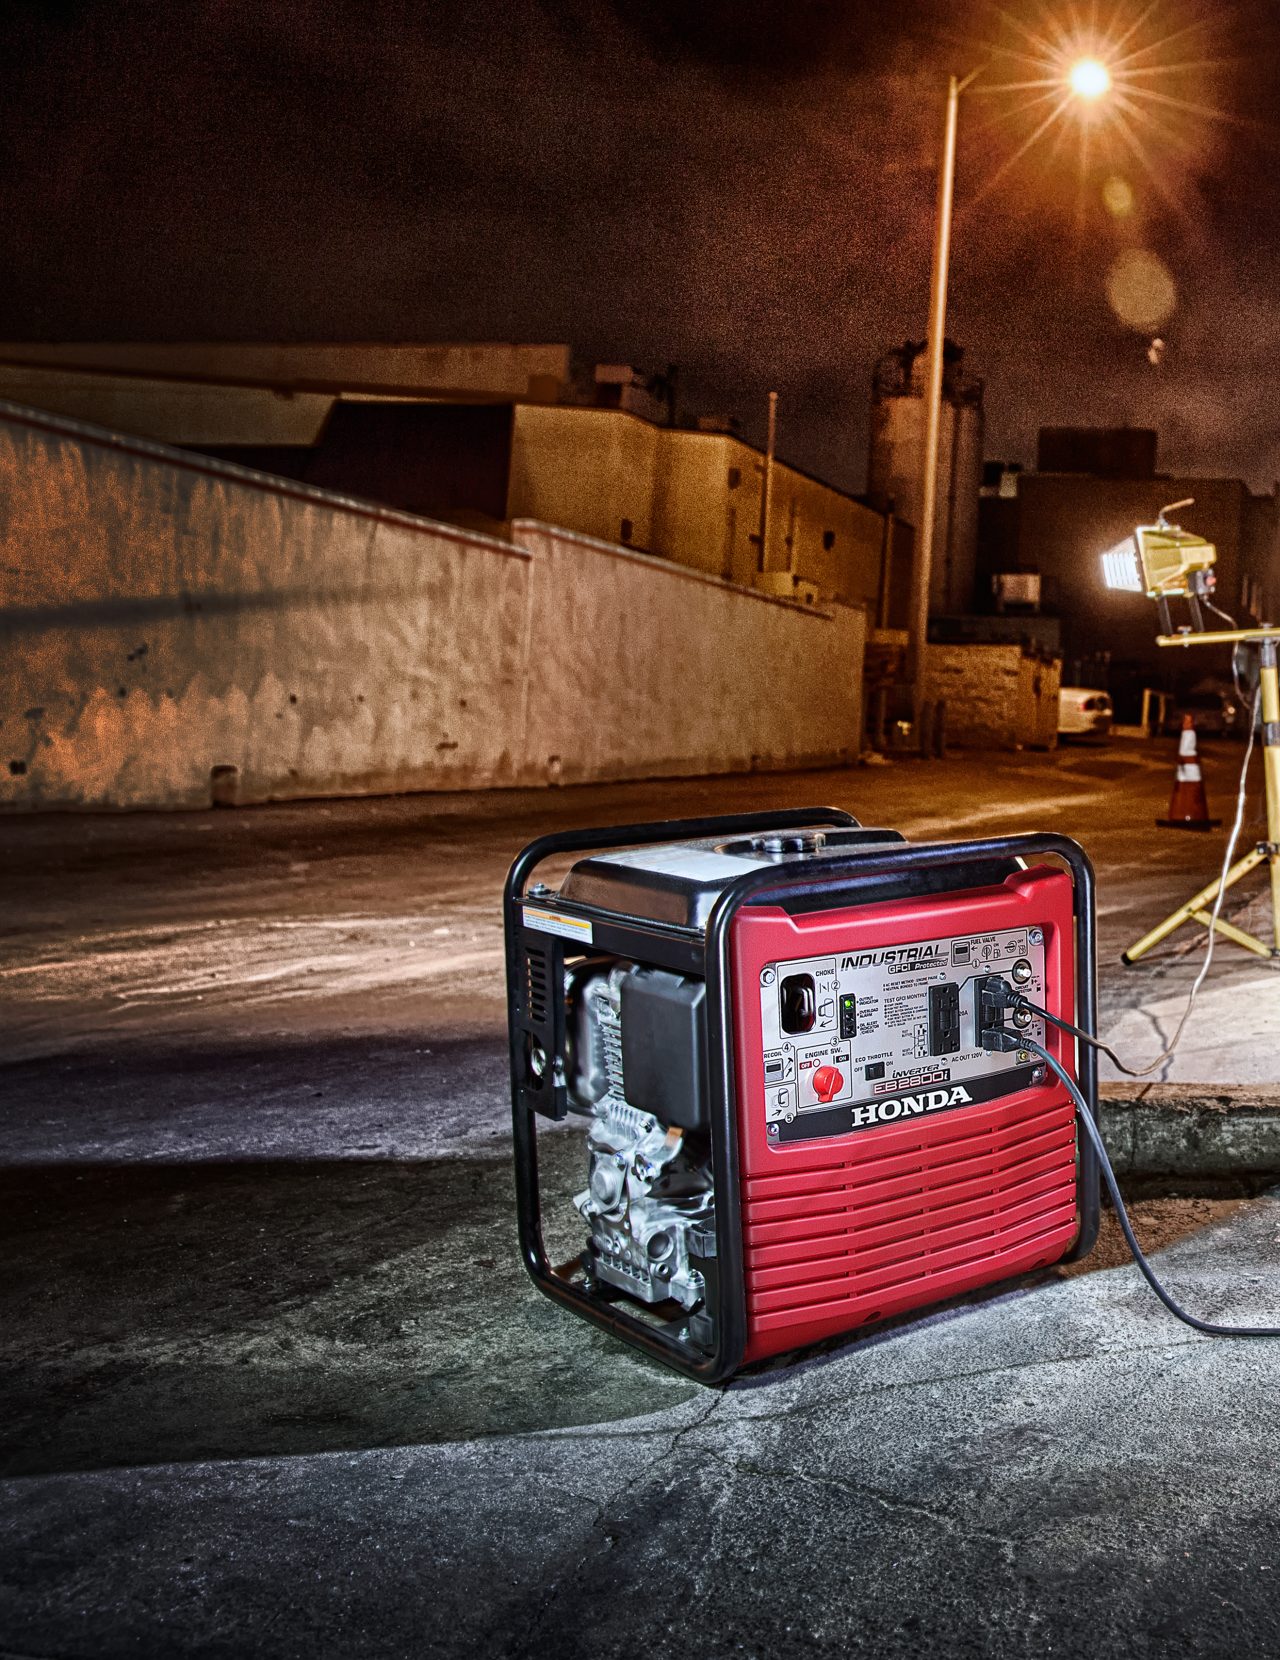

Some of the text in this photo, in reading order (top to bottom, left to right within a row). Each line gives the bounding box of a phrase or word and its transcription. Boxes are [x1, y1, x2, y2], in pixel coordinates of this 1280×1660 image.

[840, 944, 949, 971] INDUSTRIAL
[888, 958, 948, 974] GFCI Protected
[906, 992, 927, 1000] MONTHLY
[805, 1047, 843, 1058] ENGINE SW.
[867, 1052, 893, 1061] THROTTLE
[873, 1071, 949, 1094] EB2800i
[851, 1085, 973, 1127] HONDA
